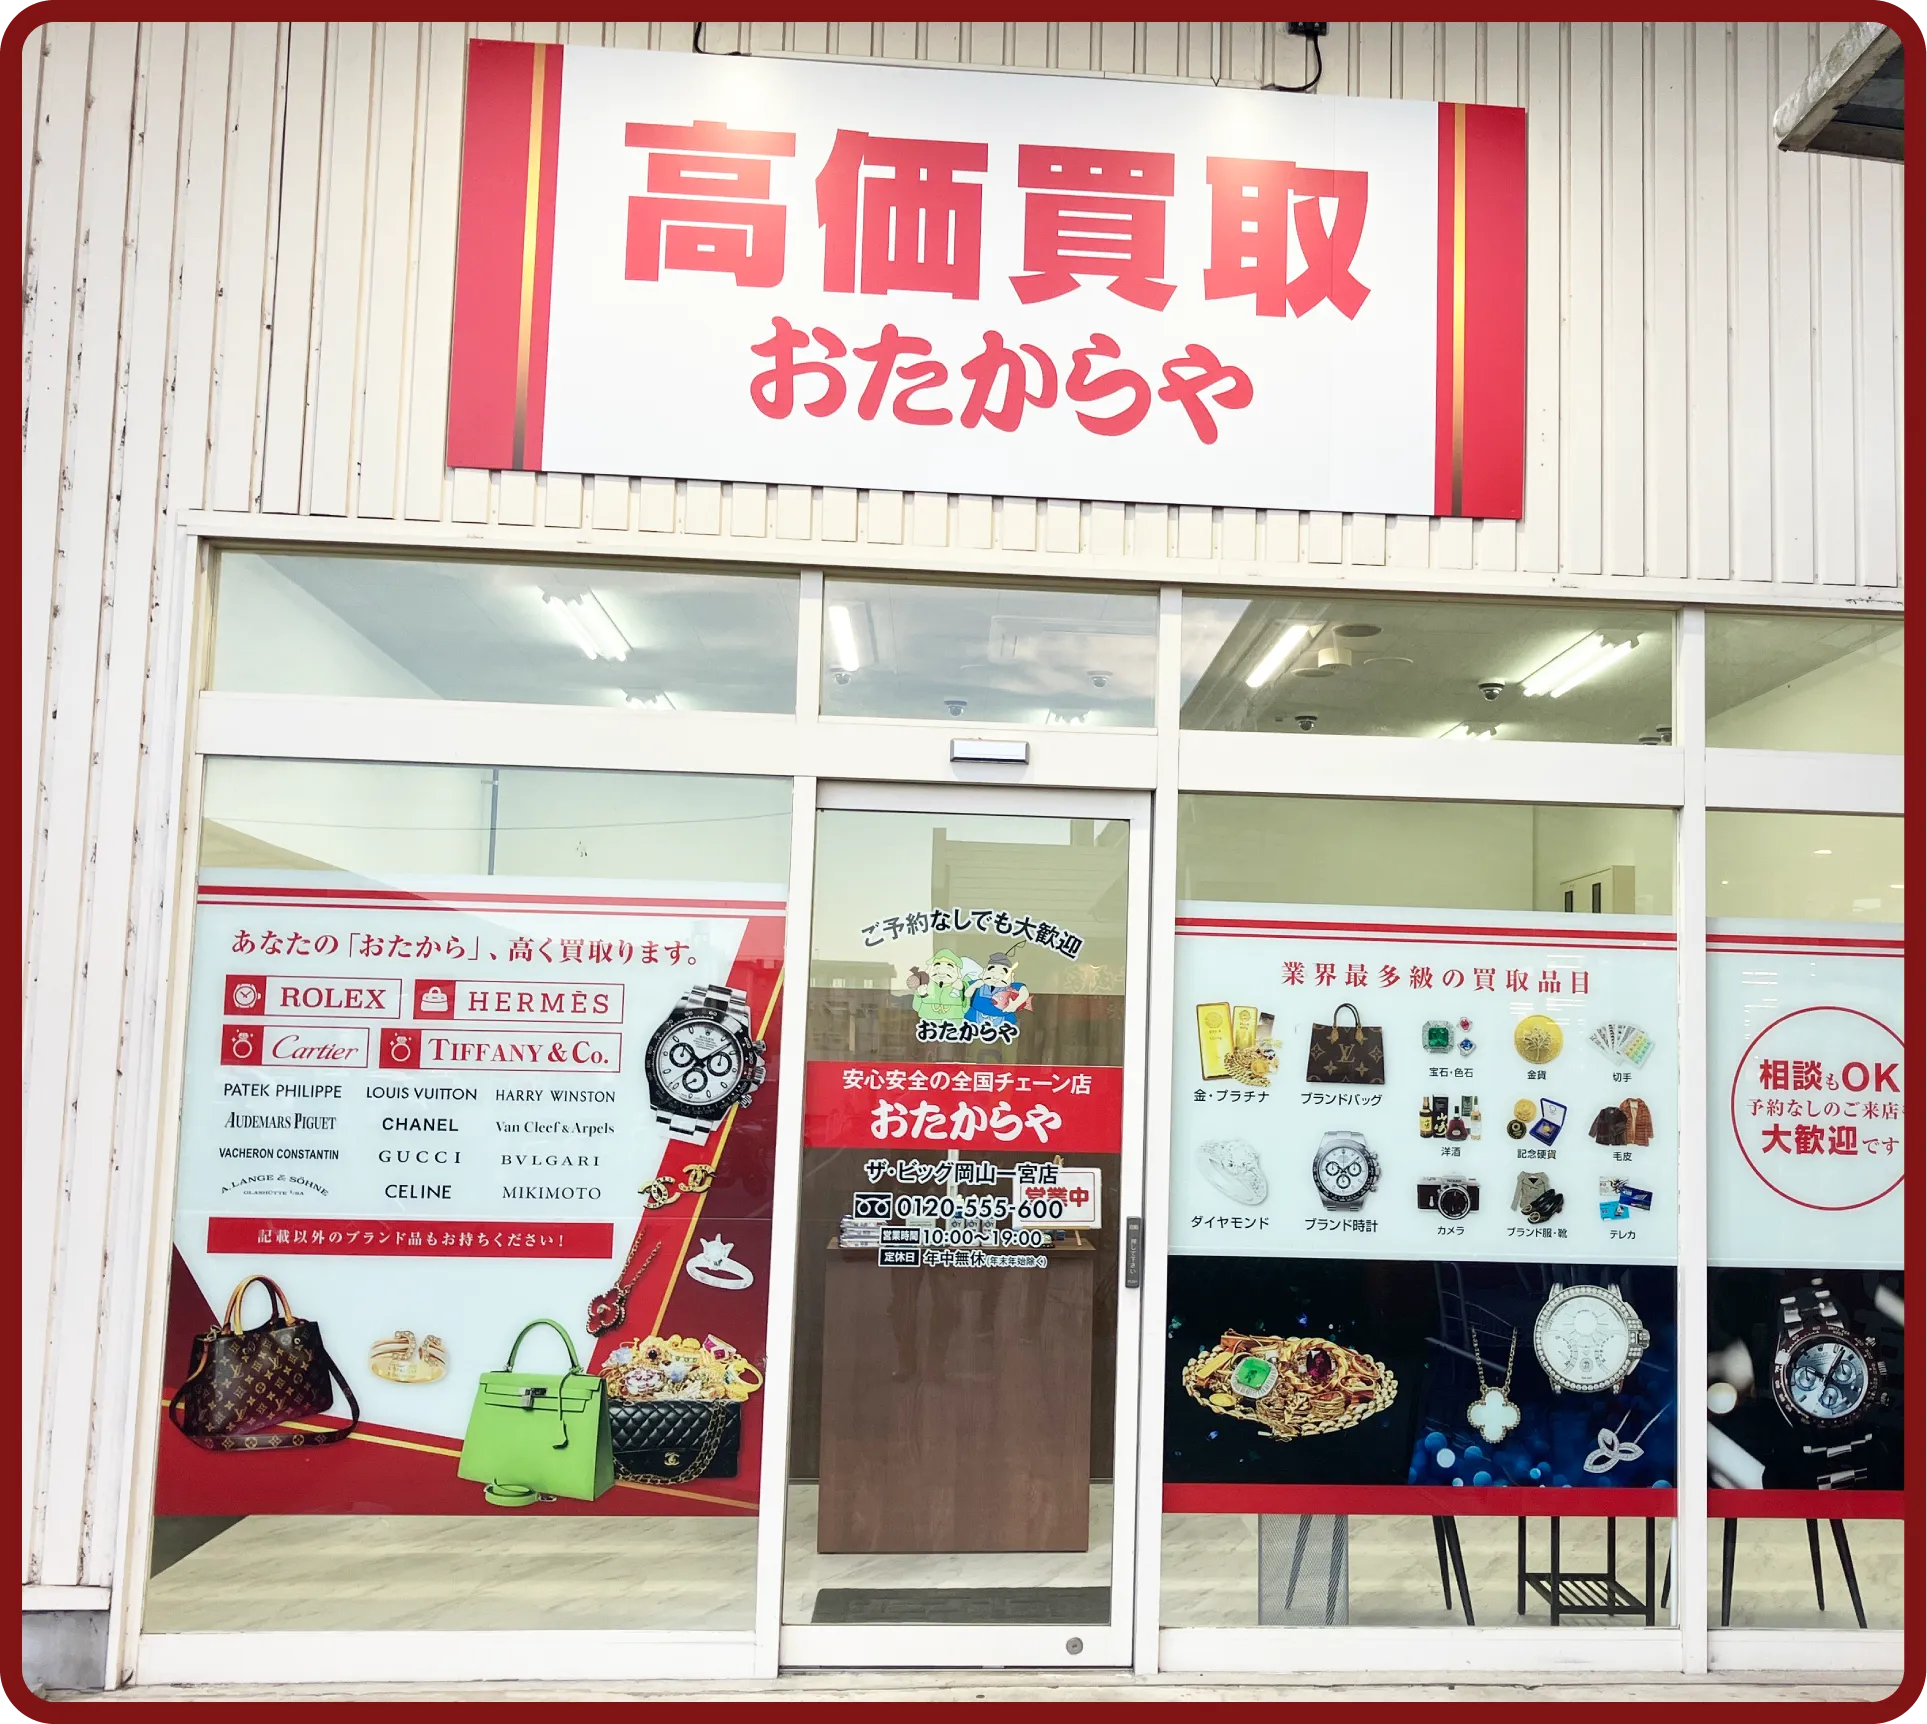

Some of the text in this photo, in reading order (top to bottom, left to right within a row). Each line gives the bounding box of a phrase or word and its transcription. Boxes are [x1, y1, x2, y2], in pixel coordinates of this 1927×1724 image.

[622, 119, 1372, 321] 高価買取
[748, 315, 1255, 445] おたからや
[860, 908, 1084, 959] ご予約なしでも大歓迎
[231, 929, 697, 966] あなたの「おたから」、高く買取ります。
[1280, 961, 1591, 995] 業界最多級の買取品目
[280, 986, 386, 1010] ROLEX
[467, 990, 610, 1014] HERMÈS
[917, 1020, 1019, 1043] おたからや
[271, 1034, 359, 1061] Cartier
[428, 1038, 544, 1062] TIFFANY
[547, 1043, 567, 1063] &
[1428, 1067, 1473, 1078] 宝石・色石
[1527, 1069, 1547, 1081] 金貨
[1612, 1072, 1632, 1083] 切手
[1759, 1058, 1901, 1093] 相談もOK
[842, 1068, 1092, 1096] 安心安全の全国チェーン店
[224, 1083, 343, 1099] PATEK PHILIPPE
[366, 1086, 478, 1101] LOUIS VUITTON
[495, 1089, 616, 1103] HARRY WINSTON
[1193, 1088, 1270, 1103] 金・プラチナ
[1300, 1092, 1383, 1107] ブランドバッグ
[1747, 1098, 1904, 1120] 予約なしのご来店
[224, 1111, 337, 1130] AUDEMARS PIGUET
[382, 1117, 459, 1132] CHANEL
[869, 1098, 1063, 1143] おたからや
[495, 1121, 520, 1133] Van
[523, 1121, 561, 1134] Cleef
[571, 1122, 616, 1137] Arpels
[1761, 1123, 1900, 1156] 大歓迎です
[219, 1147, 339, 1160] VACHERON CONSTANTIN
[378, 1150, 461, 1164] GUCCI
[1441, 1146, 1461, 1157] 洋酒
[1517, 1149, 1557, 1160] 記念硬貨
[1612, 1151, 1633, 1162] 毛皮
[501, 1154, 600, 1167] BVLGARI
[865, 1161, 1060, 1185] ザ・ビッグ岡山一宮店
[288, 1176, 329, 1197] SÖHNE
[384, 1184, 452, 1199] CELINE
[502, 1186, 602, 1200] MIKIMOTO
[895, 1197, 1063, 1219] 0120-555-600
[1190, 1215, 1269, 1230] ダイヤモンド
[1305, 1218, 1379, 1233] ブランド時計
[882, 1229, 920, 1242] 営業時間
[1437, 1225, 1465, 1236] カメラ
[1507, 1227, 1568, 1239] ブランド服・靴
[1609, 1229, 1636, 1240] テレカ
[884, 1251, 916, 1263] 定休日
